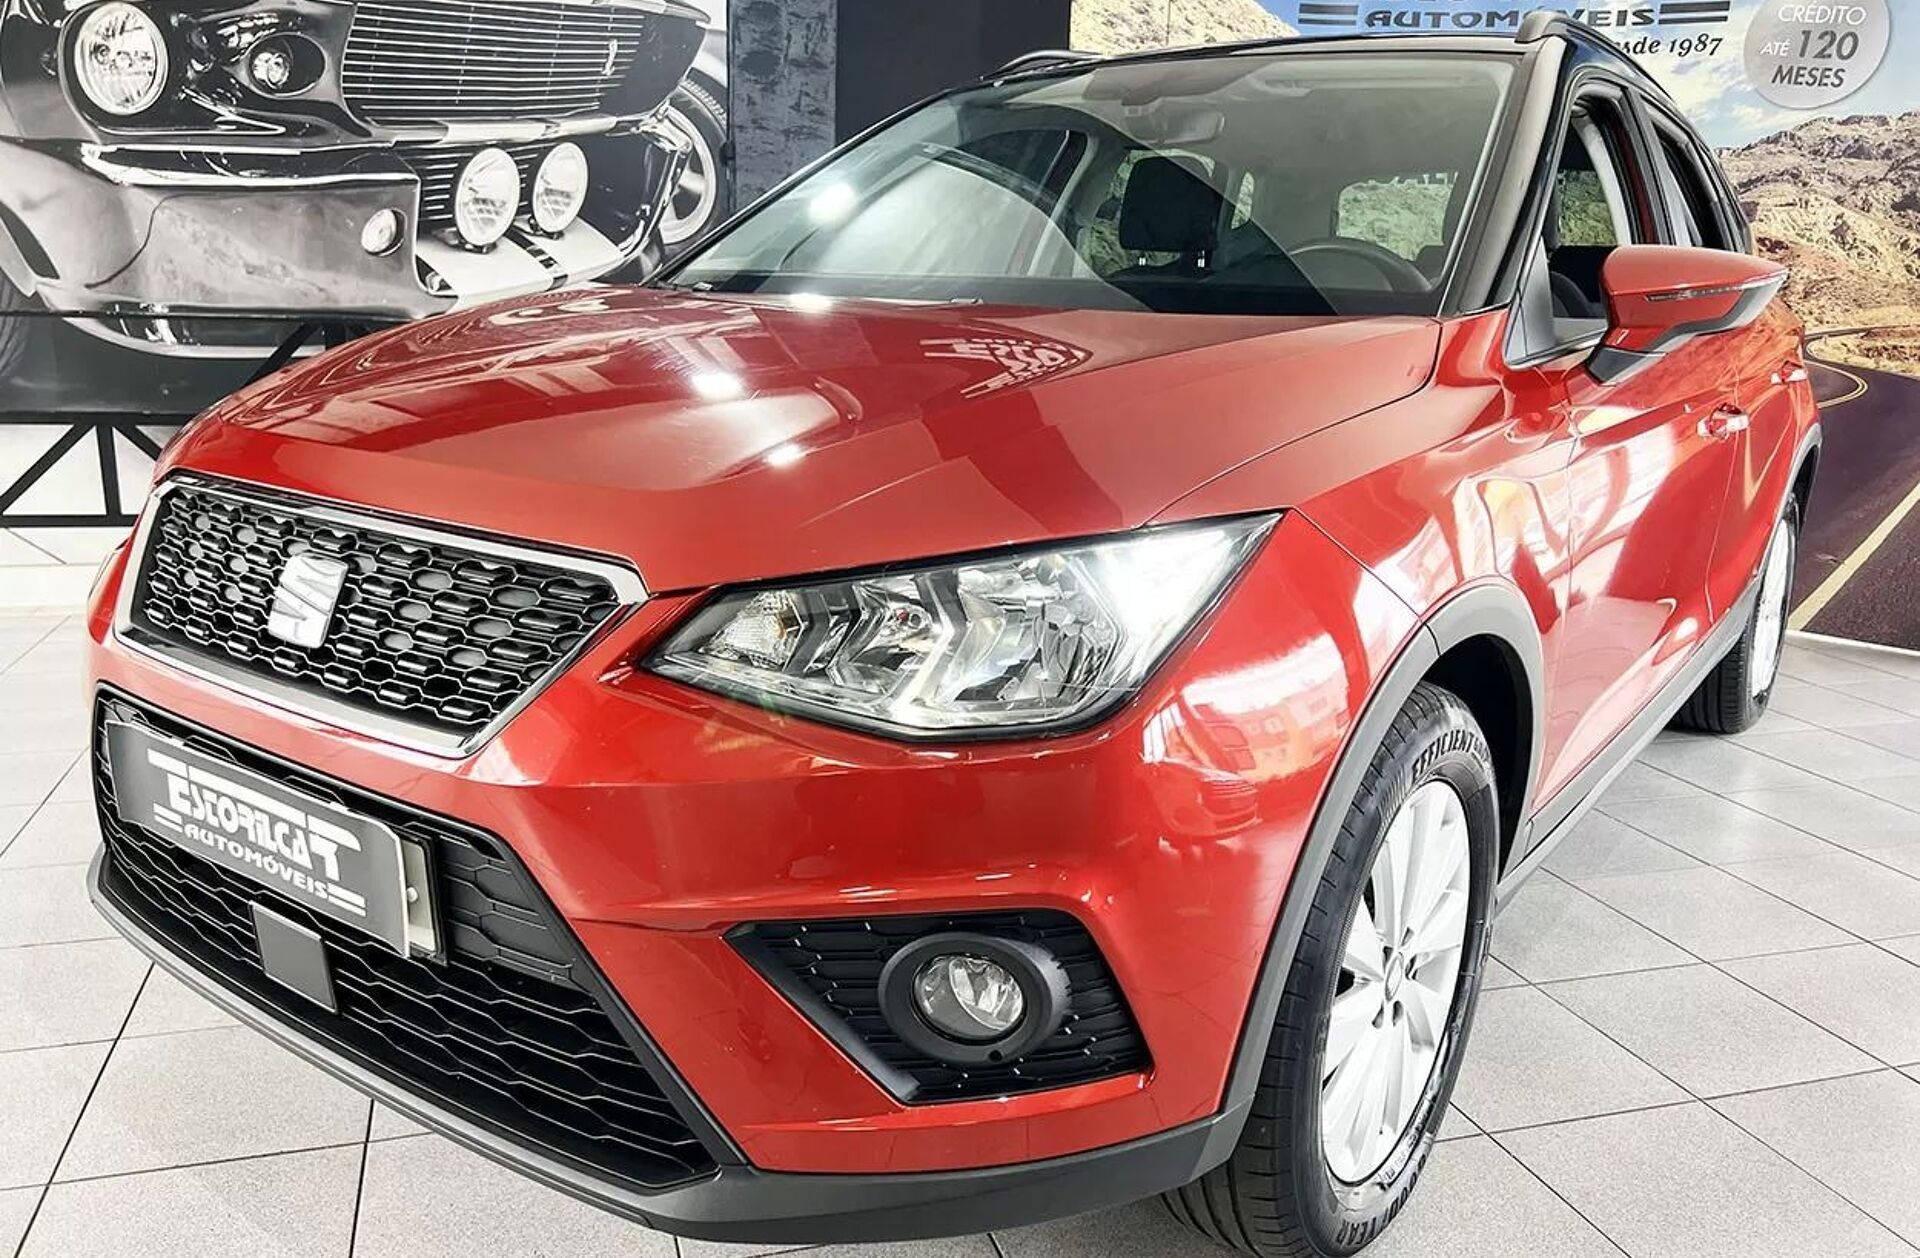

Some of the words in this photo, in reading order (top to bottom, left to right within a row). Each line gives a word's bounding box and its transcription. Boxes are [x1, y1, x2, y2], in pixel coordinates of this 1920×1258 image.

[1778, 1, 1866, 25] CRÉDITO
[1613, 36, 1661, 55] sde
[1669, 33, 1723, 57] 1987
[1760, 40, 1790, 56] ATÉ
[1799, 30, 1859, 60] 120
[1771, 64, 1846, 88] MESES
[185, 823, 329, 900] AUTOMÓVEIS
